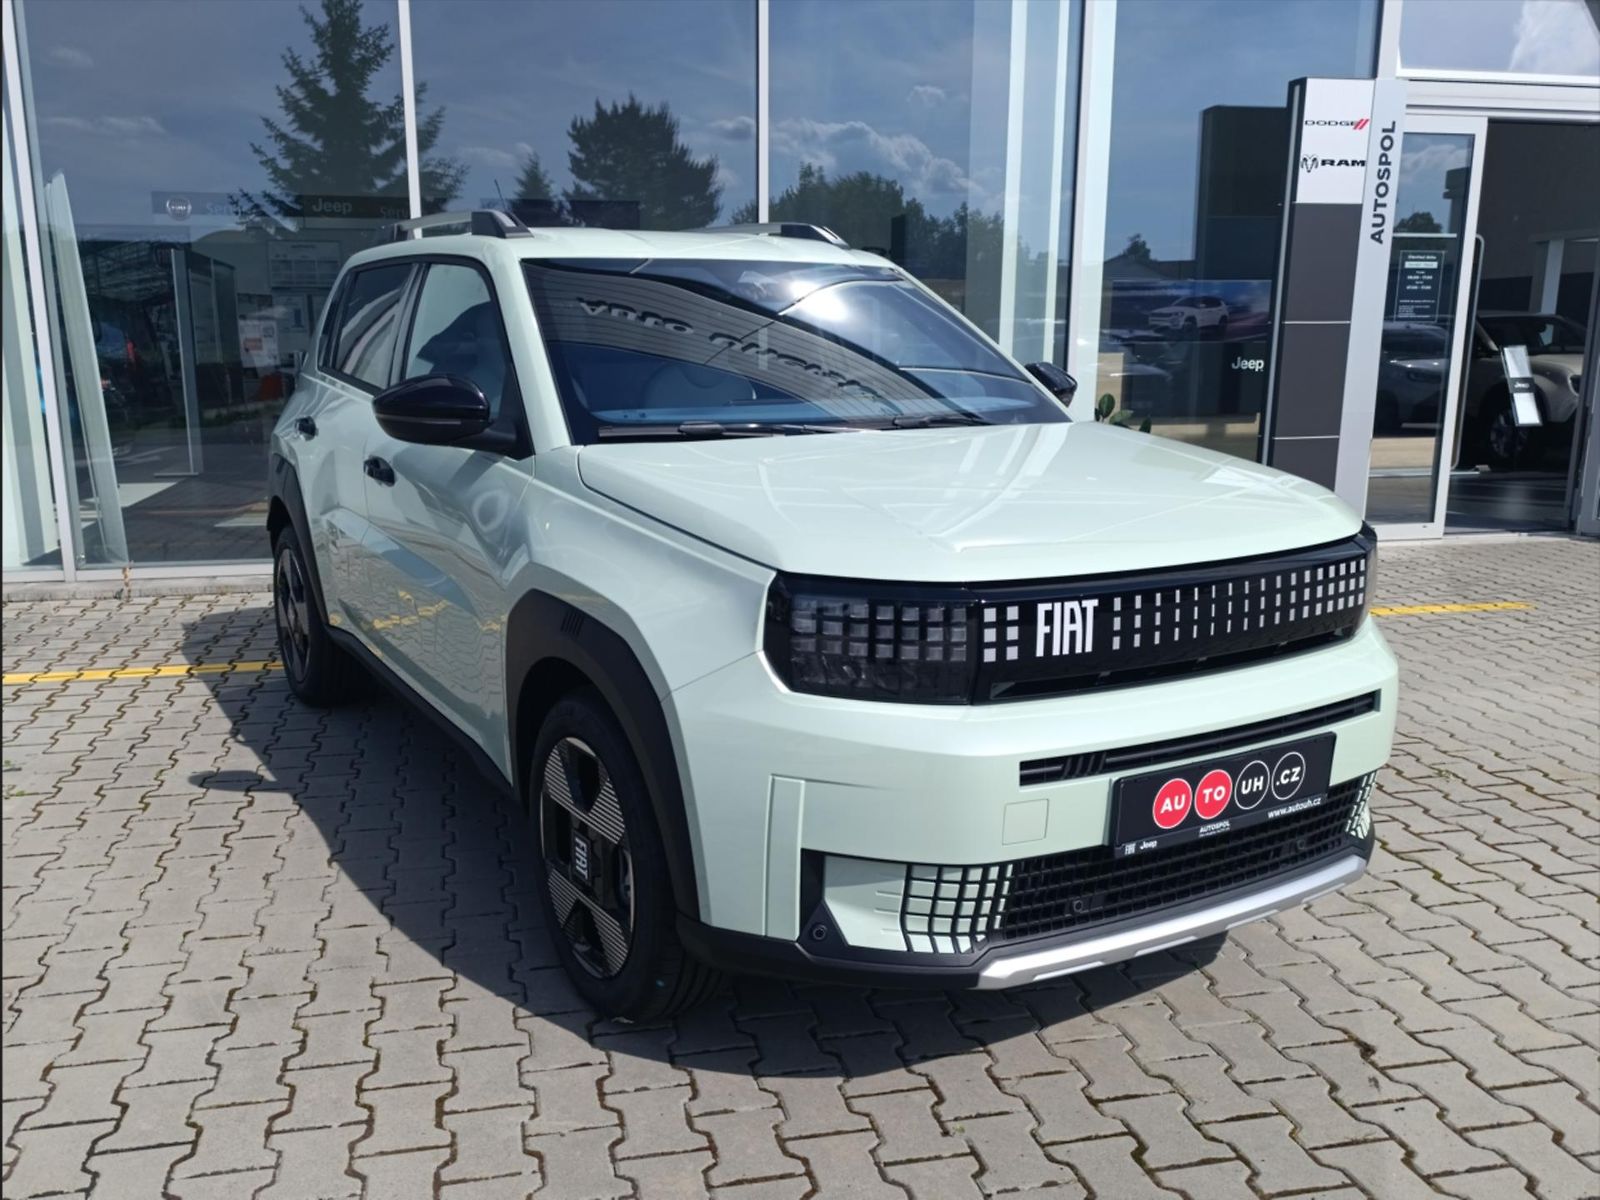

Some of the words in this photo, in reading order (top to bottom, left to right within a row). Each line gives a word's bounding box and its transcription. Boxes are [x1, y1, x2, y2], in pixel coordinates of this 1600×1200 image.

[1304, 119, 1358, 127] DODGE
[1320, 158, 1367, 167] RAM
[1370, 120, 1397, 245] AUTOSPOL
[311, 197, 353, 215] Jeep
[1231, 356, 1265, 372] Jeep
[1035, 598, 1099, 658] FIAT
[1160, 794, 1186, 814] AU
[1202, 785, 1226, 804] TO
[1240, 776, 1264, 795] UH
[1267, 797, 1322, 819] www.autouh.cz
[1199, 820, 1231, 833] AUTOSPOL
[574, 836, 589, 881] FIAT
